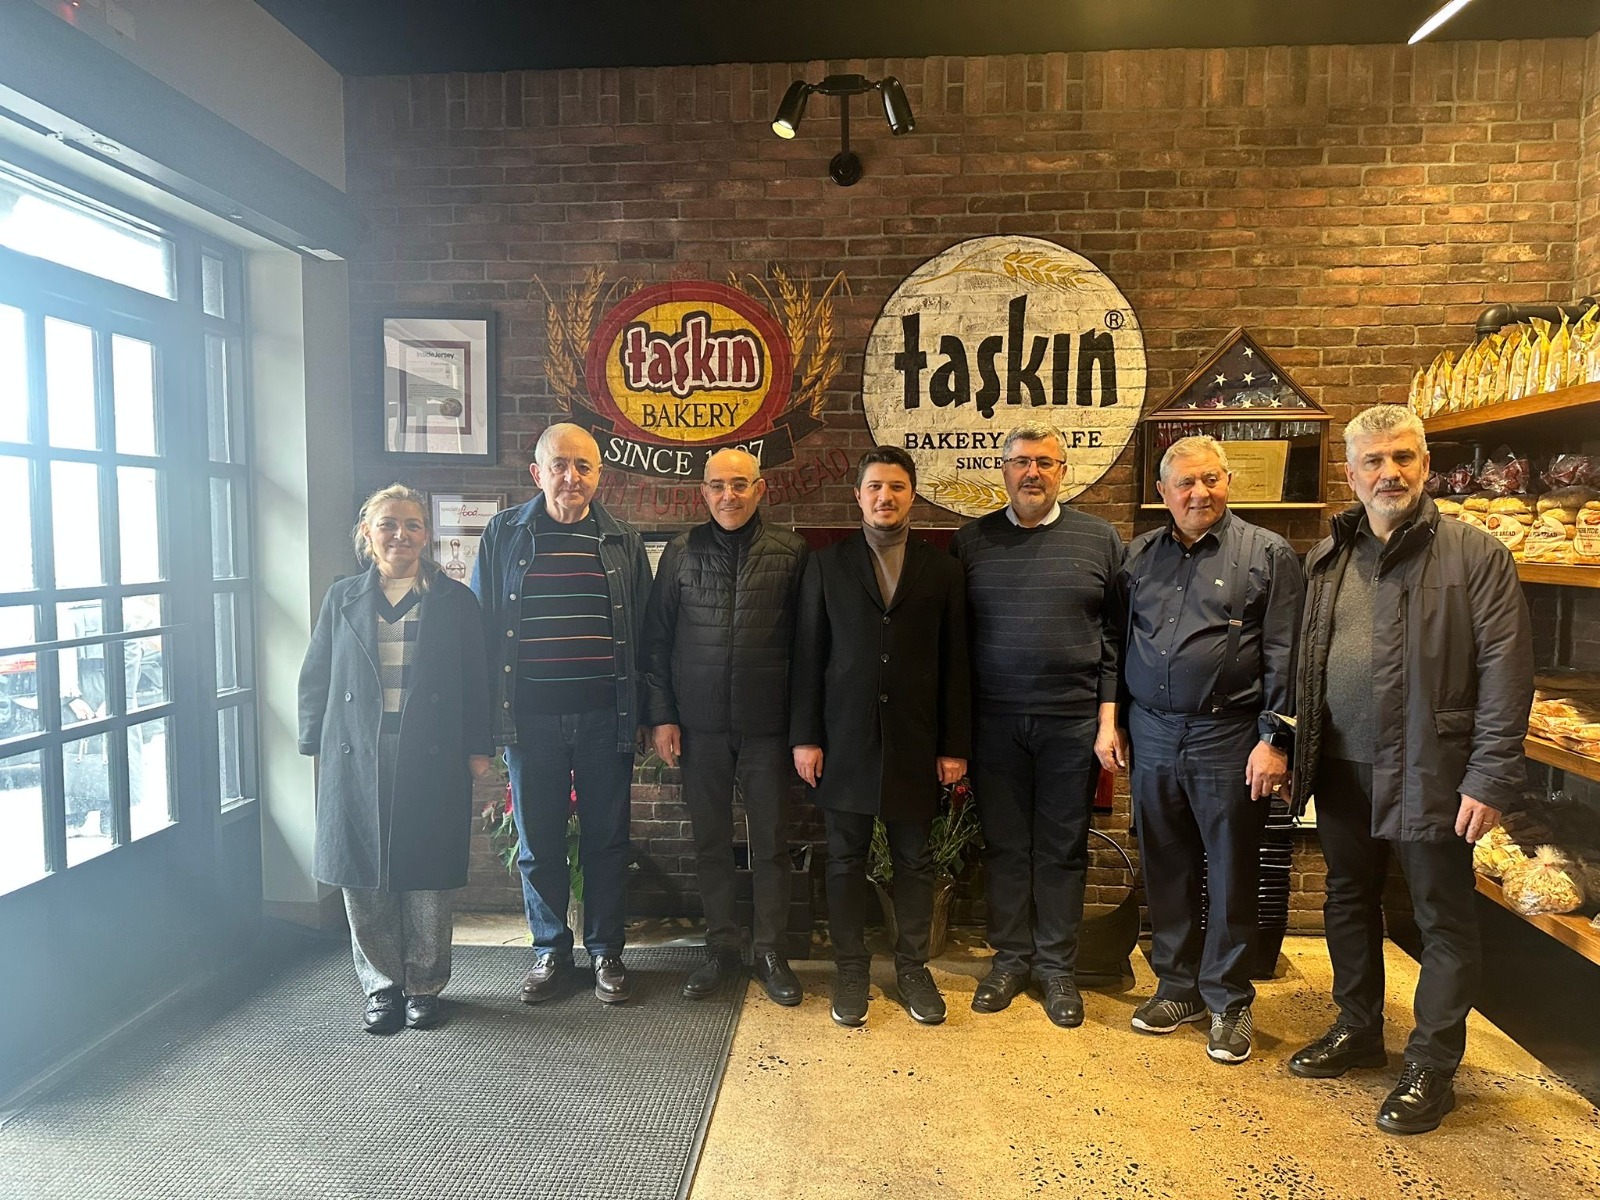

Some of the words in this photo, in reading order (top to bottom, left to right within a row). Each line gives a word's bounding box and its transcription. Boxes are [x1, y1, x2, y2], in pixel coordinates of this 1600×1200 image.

[641, 402, 739, 428] BAKERY
[904, 431, 1004, 449] BAKERY
[1061, 430, 1103, 448] FE
[604, 437, 694, 476] SINCE
[956, 456, 1003, 470] SINCE
[635, 479, 709, 517] TURK
[766, 448, 850, 507] BREAD
